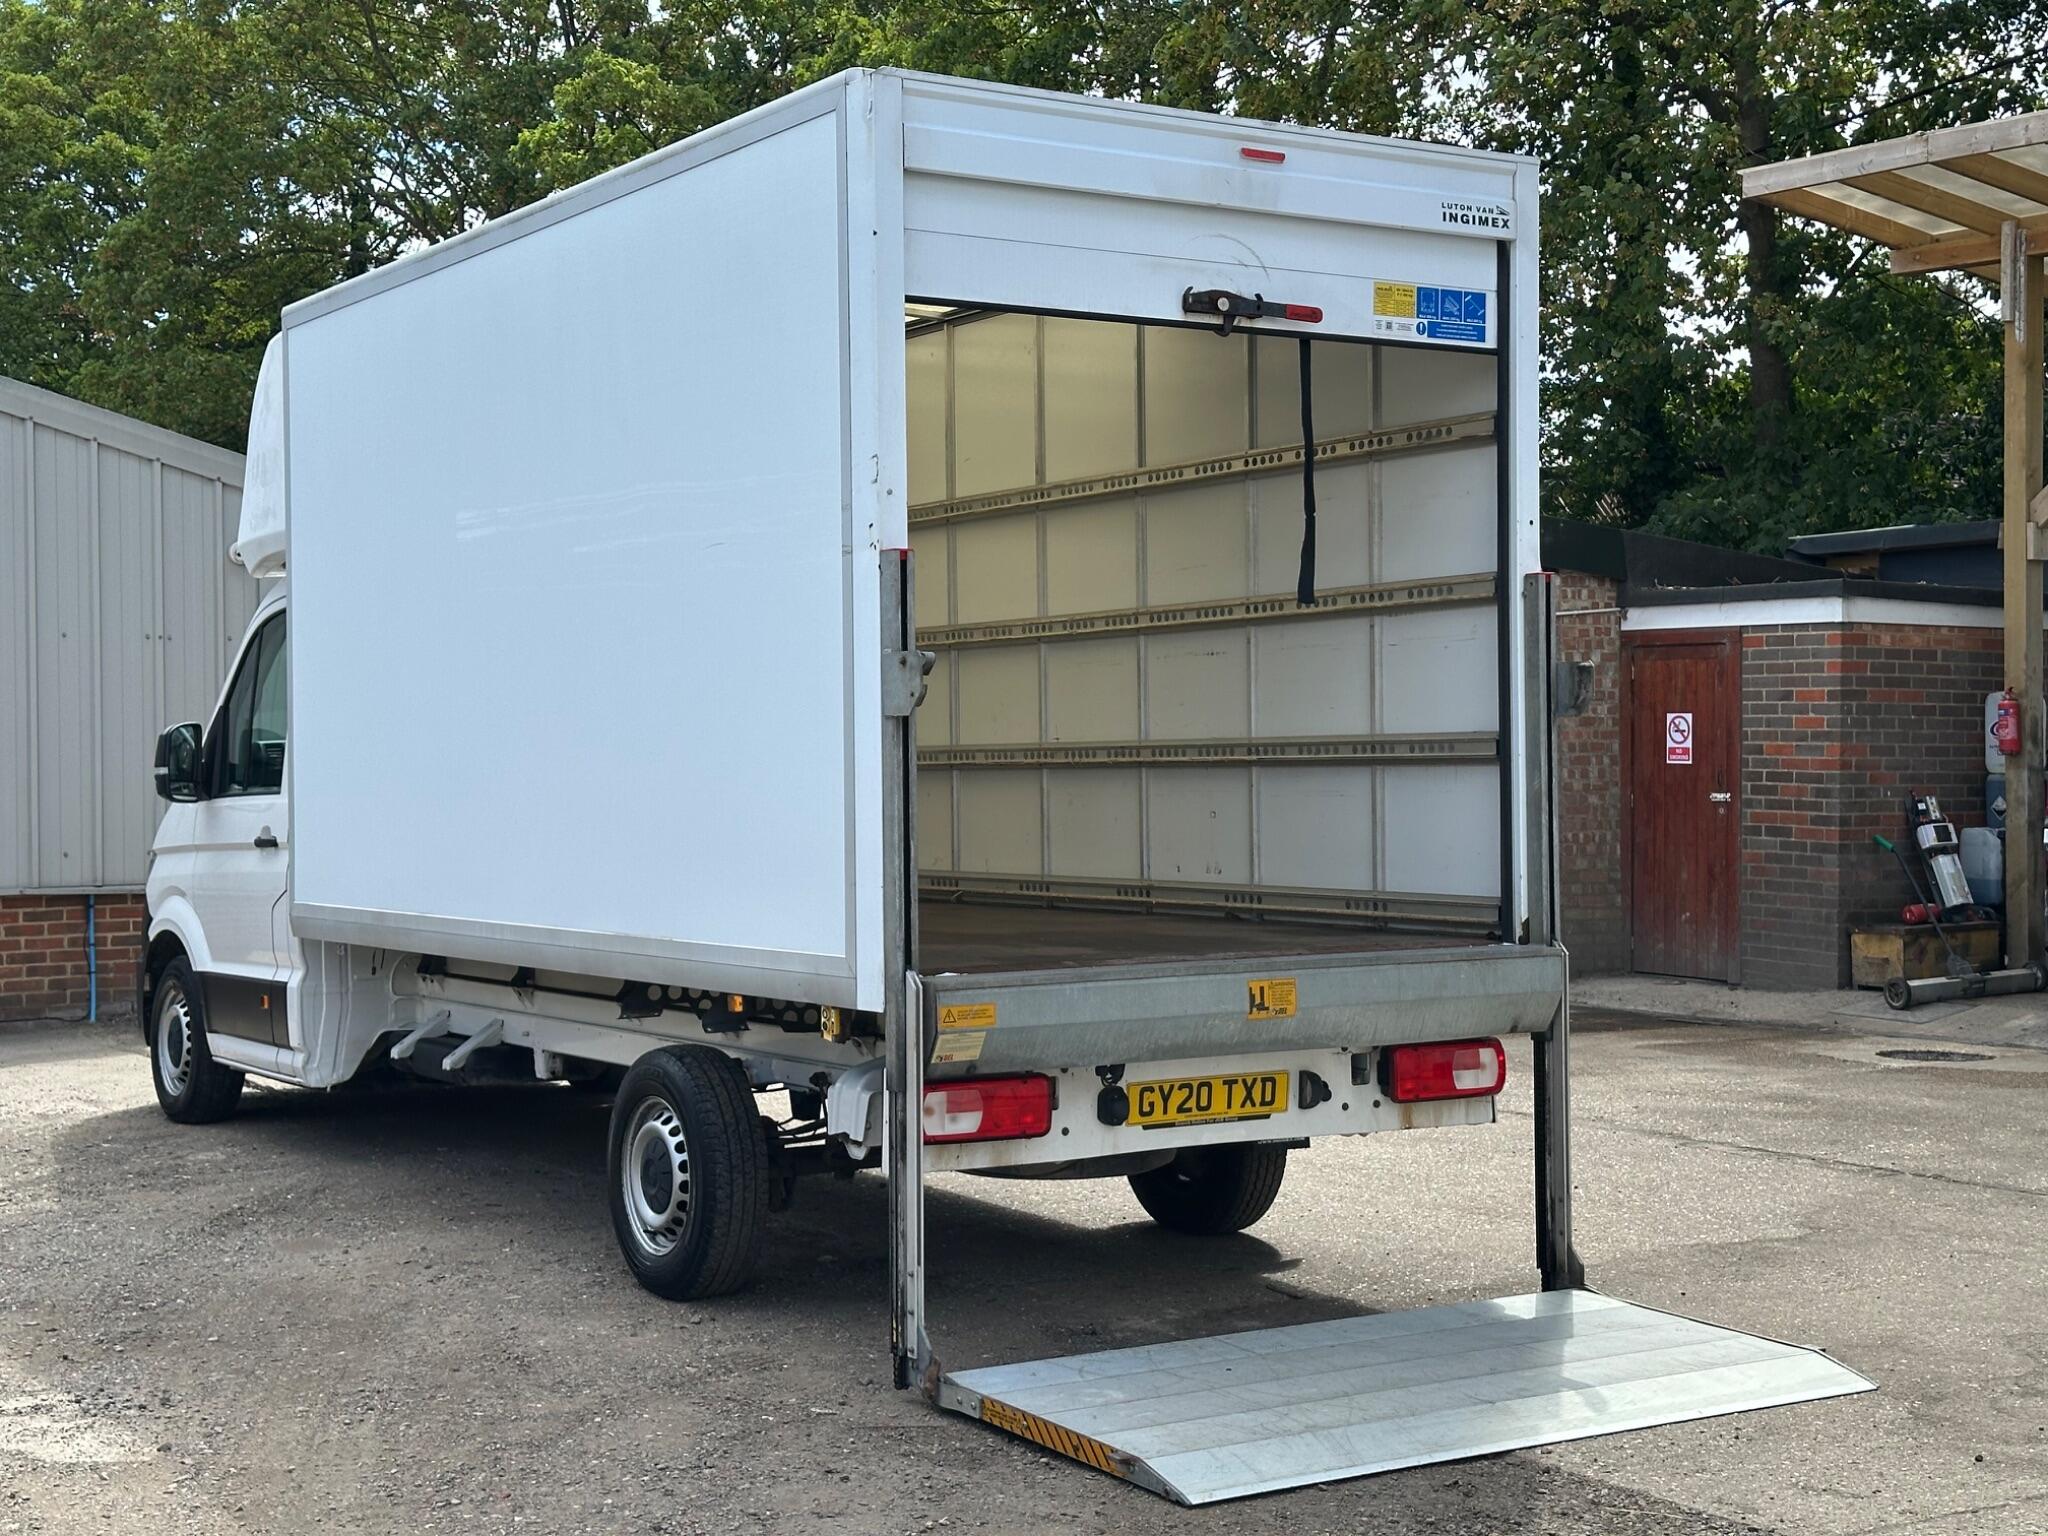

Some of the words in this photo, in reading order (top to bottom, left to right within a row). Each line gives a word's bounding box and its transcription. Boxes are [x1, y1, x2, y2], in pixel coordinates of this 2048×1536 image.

[1441, 202, 1472, 212] LUTON
[1476, 206, 1494, 214] VAN
[1442, 211, 1510, 229] INGIMEX
[1138, 1081, 1212, 1118] GY20
[1222, 1076, 1277, 1110] TXD
